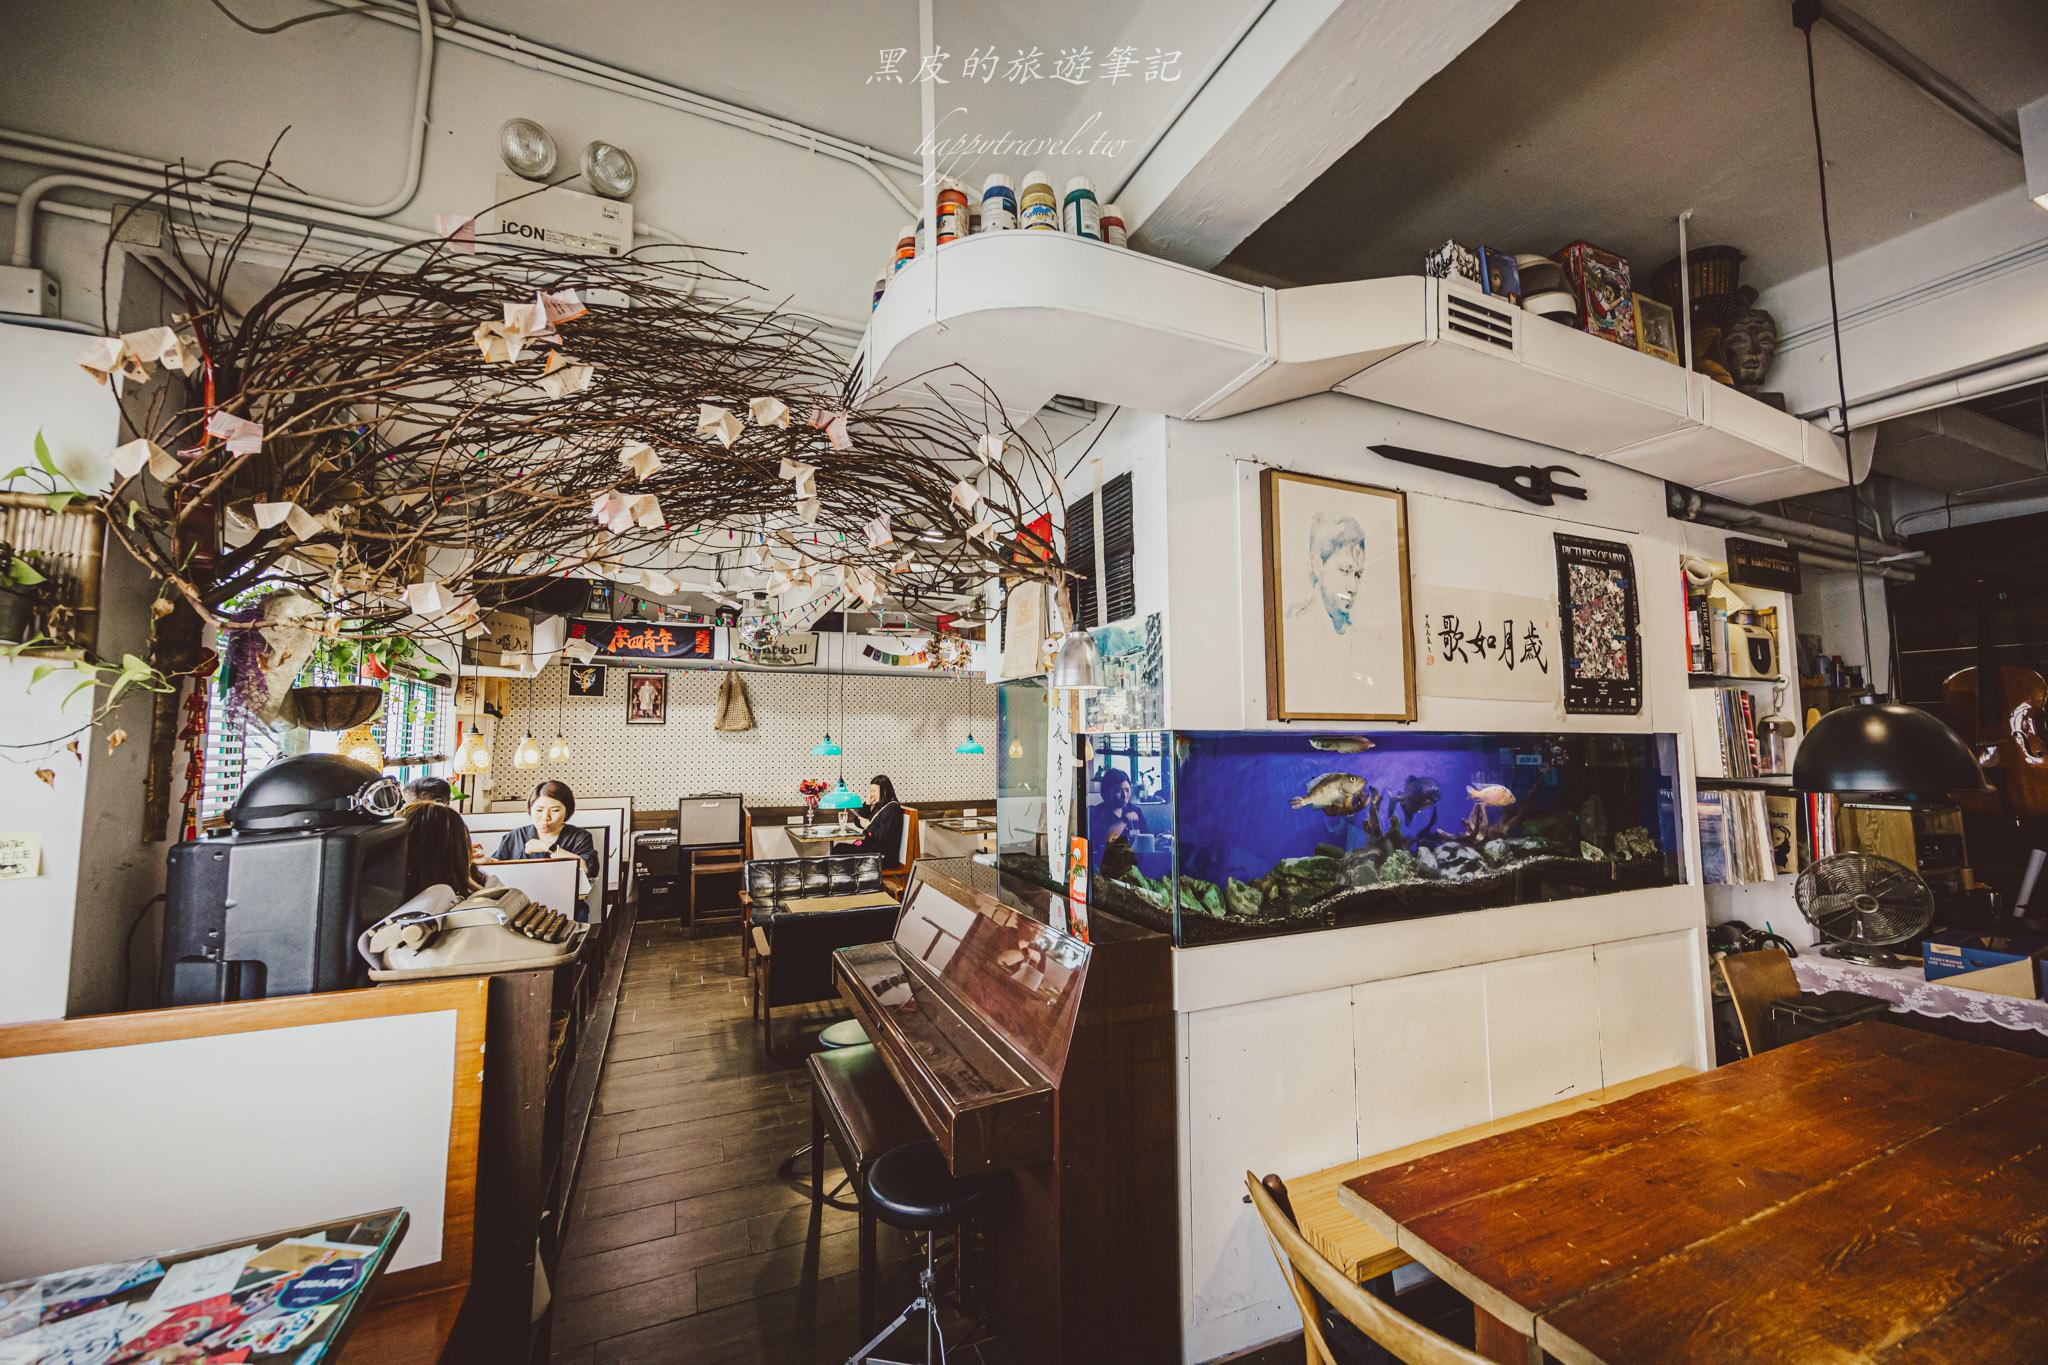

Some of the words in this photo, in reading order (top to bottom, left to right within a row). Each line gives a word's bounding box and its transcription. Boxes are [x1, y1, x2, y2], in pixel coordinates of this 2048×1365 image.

[502, 220, 545, 241] iCON
[1437, 613, 1549, 675] 歲月如歌
